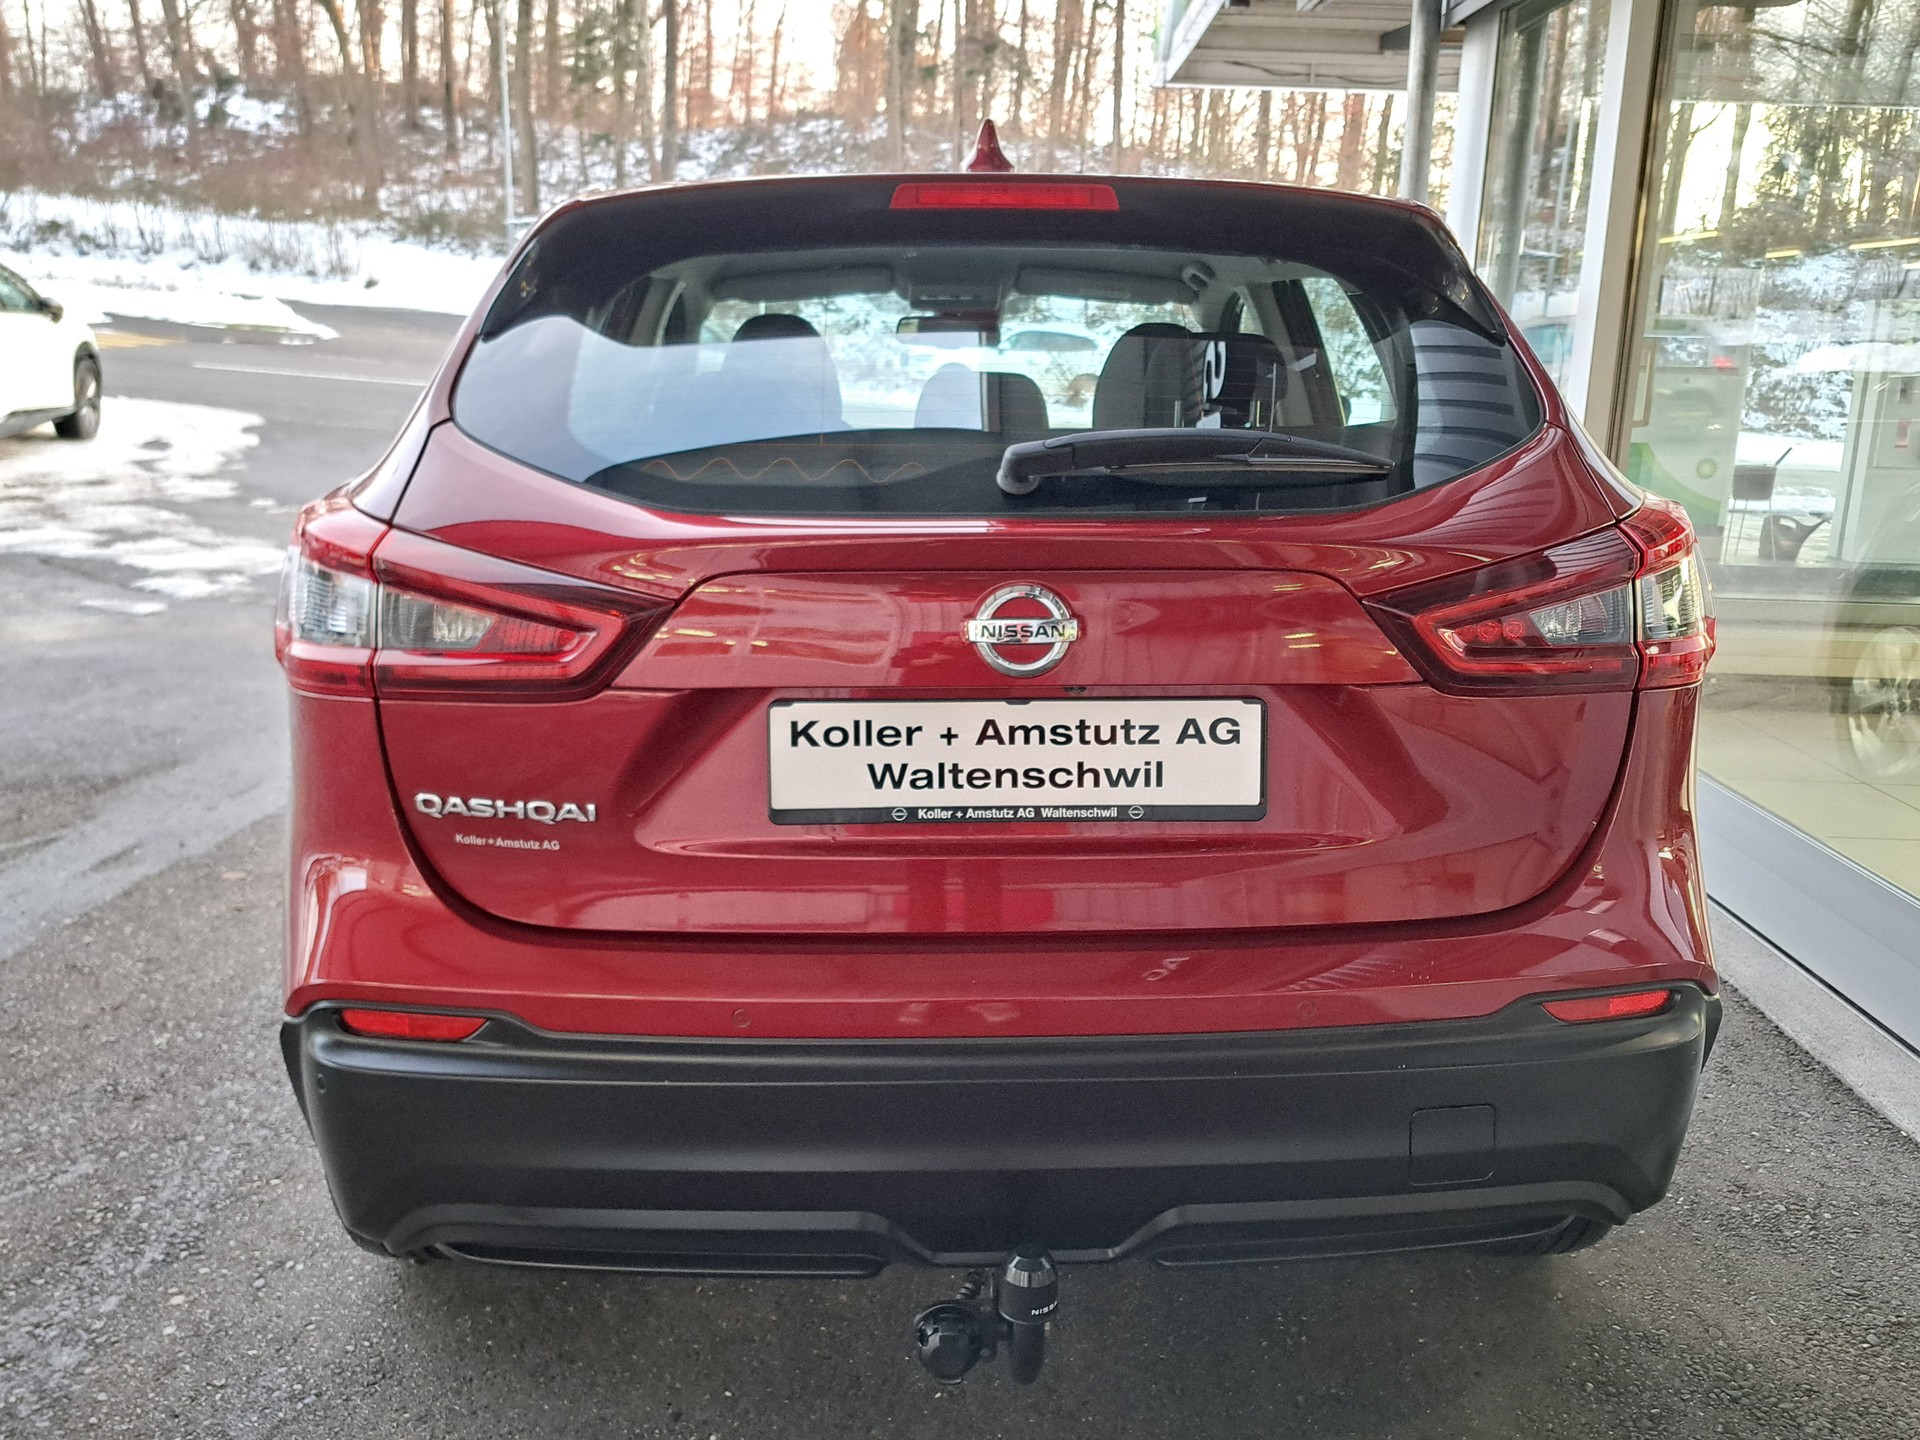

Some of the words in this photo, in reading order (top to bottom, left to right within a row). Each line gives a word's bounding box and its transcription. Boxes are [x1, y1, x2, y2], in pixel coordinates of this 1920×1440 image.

[981, 624, 1066, 638] NISSAN
[790, 719, 923, 748] Koller
[939, 726, 959, 746] +
[975, 718, 1160, 746] Amstutz
[1175, 717, 1241, 745] AG
[866, 760, 1164, 790] Waltenschwil
[414, 792, 597, 825] QASHQAI
[917, 808, 954, 820] Koller
[955, 810, 964, 819] +
[965, 807, 1015, 819] Amstutz
[1016, 807, 1035, 819] AG
[1040, 806, 1118, 819] Waltenschwil
[542, 839, 560, 851] AG
